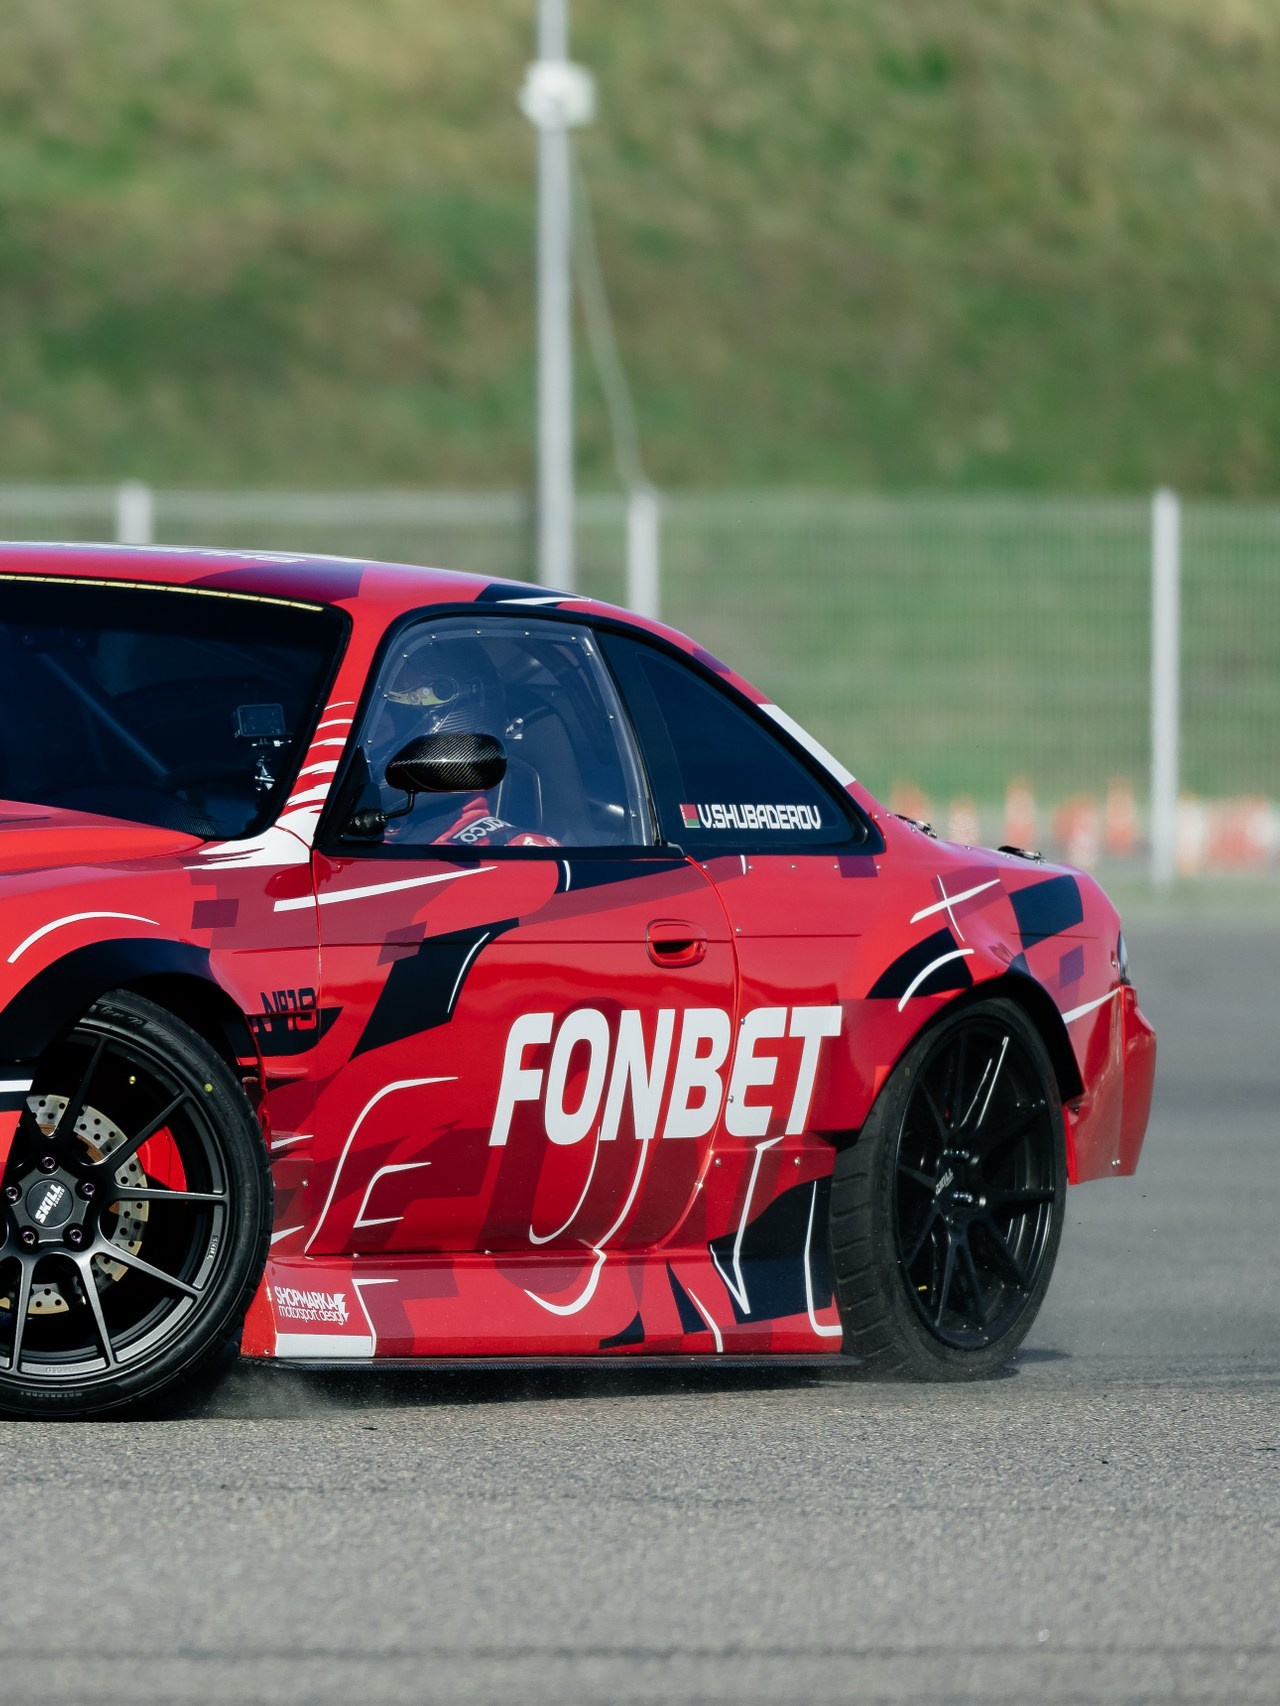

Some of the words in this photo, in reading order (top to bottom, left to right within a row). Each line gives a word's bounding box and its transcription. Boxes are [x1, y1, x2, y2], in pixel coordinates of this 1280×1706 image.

[698, 804, 821, 829] V.SHUBADEROV
[488, 1005, 843, 1147] FONBET
[35, 1185, 62, 1224] SKILL
[274, 1286, 338, 1310] SHOPMARKA
